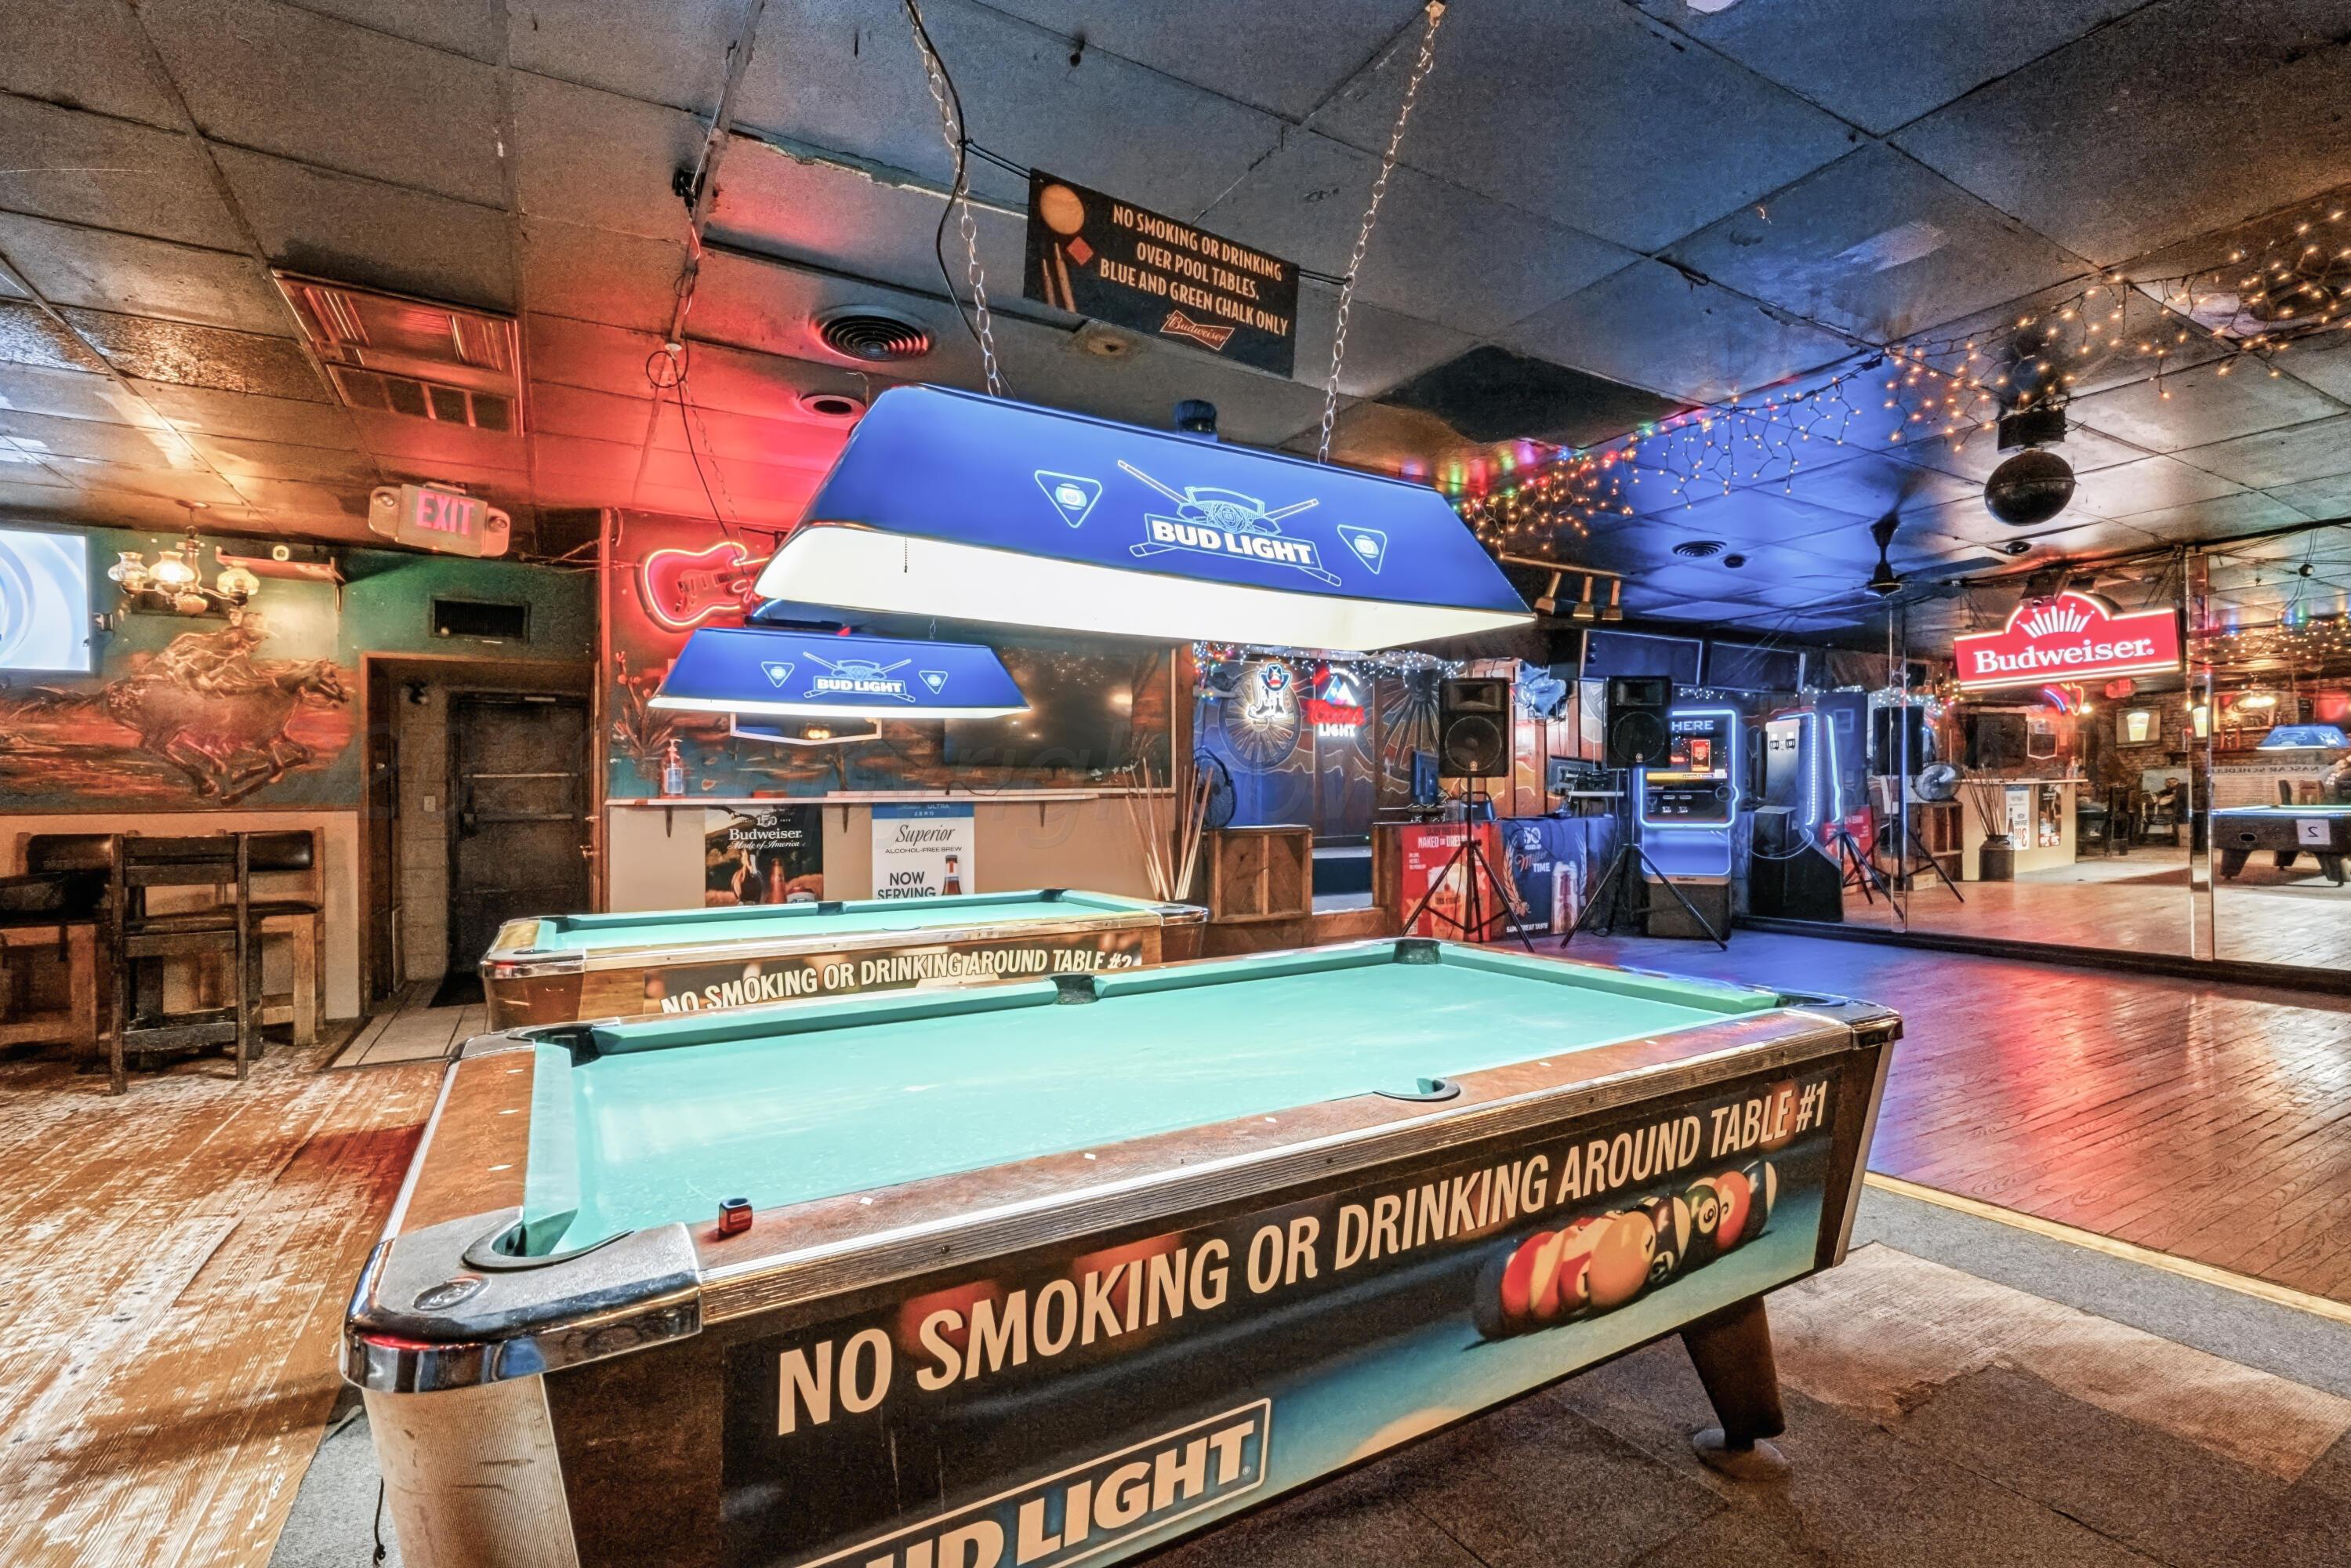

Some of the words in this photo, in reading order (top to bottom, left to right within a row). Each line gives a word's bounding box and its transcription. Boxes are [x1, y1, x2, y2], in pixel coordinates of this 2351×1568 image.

[1113, 204, 1134, 228] NO
[1137, 213, 1198, 251] SMOKING
[1201, 237, 1220, 259] OR
[1222, 244, 1283, 281] DRINKING
[1137, 242, 1172, 270] OVER
[1175, 254, 1209, 283] POOL
[1212, 266, 1259, 300] TABLES.
[1100, 258, 1136, 288] BLUE
[1138, 271, 1166, 296] AND
[1170, 282, 1213, 312] GREEN
[1215, 296, 1254, 325] CHALK
[1256, 313, 1288, 336] ONLY
[1166, 314, 1228, 343] Budweiser
[416, 489, 477, 535] EXIT
[1152, 519, 1221, 550] BUD
[1224, 534, 1312, 564] LIGHT
[1973, 638, 2152, 674] Budweiser
[817, 677, 851, 691] BUD
[854, 680, 903, 692] LIGHT
[1319, 723, 1355, 737] LIGHT
[1671, 720, 1714, 731] HERE
[727, 840, 755, 850] Made
[756, 840, 766, 850] of
[765, 839, 800, 849] America
[729, 827, 801, 840] Budweiser
[895, 824, 956, 846] Superior
[1417, 836, 1439, 848] NAKED
[890, 871, 925, 886] NOW
[1533, 862, 1551, 873] TIME
[877, 886, 937, 900] SERVING
[659, 990, 700, 1014] NO
[705, 967, 818, 1010] SMOKING
[822, 962, 855, 990] OR
[861, 952, 964, 985] DRINKING
[967, 949, 1048, 976] AROUND
[1052, 949, 1105, 972] TABLE
[778, 1328, 893, 1436] NO
[916, 1239, 1230, 1392] SMOKING
[1247, 1214, 1319, 1295] OR
[1334, 1154, 1549, 1271] DRINKING
[1556, 1115, 1701, 1205] AROUND
[1709, 1087, 1794, 1159] TABLE
[1794, 1080, 1827, 1134] #1
[1017, 1420, 1254, 1566] LIGHT
